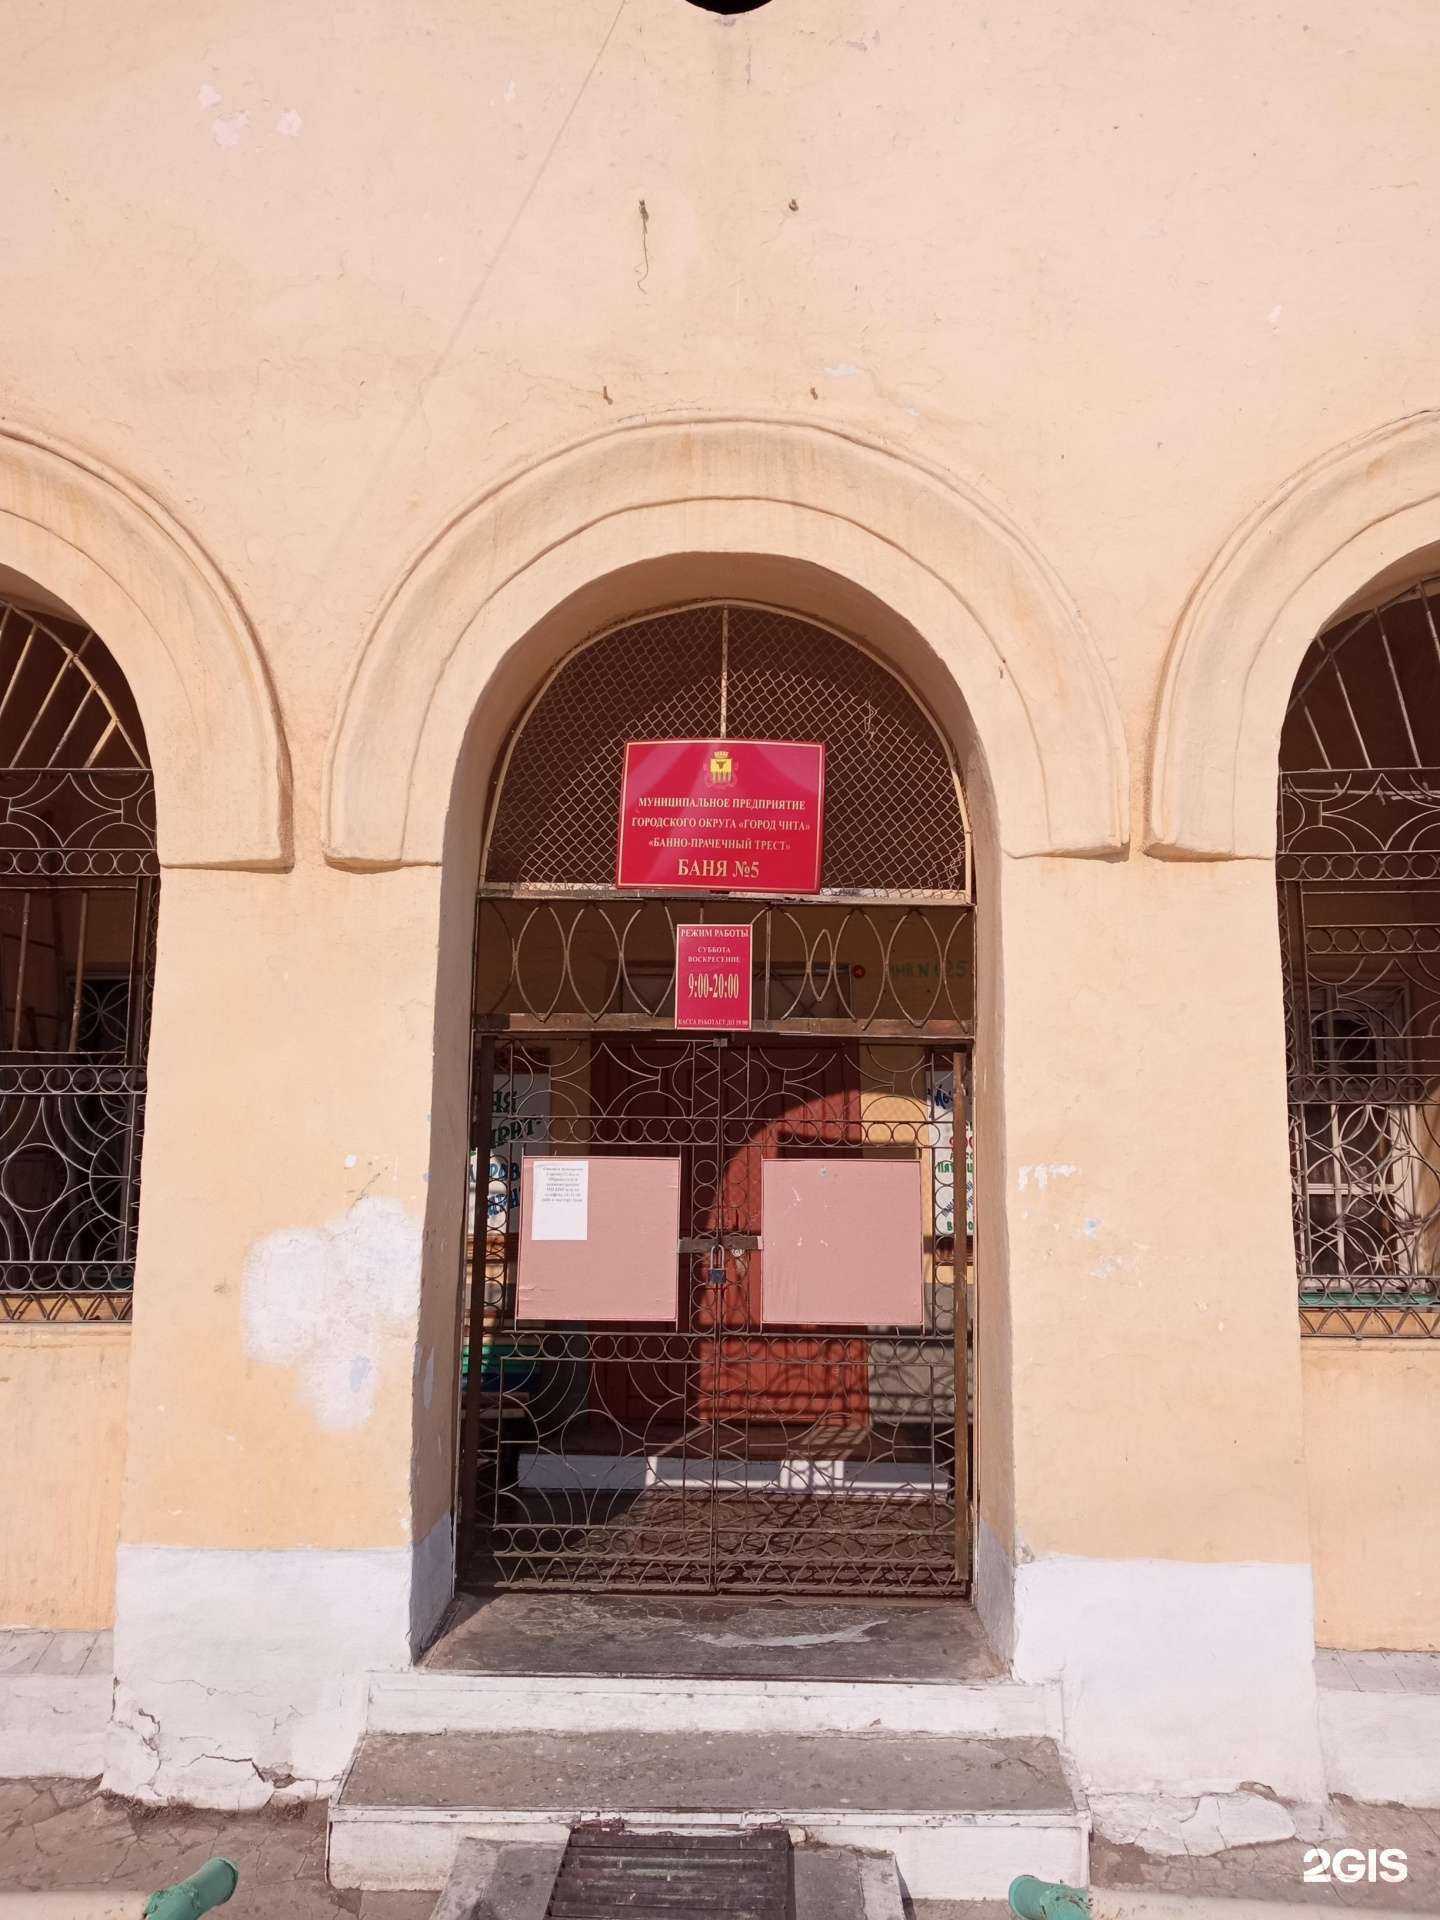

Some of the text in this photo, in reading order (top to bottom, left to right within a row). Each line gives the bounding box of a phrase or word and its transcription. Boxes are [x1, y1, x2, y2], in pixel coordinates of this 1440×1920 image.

[638, 797, 807, 810] МУНИЦИПАЛЬНОЕ ПРЕДПРИЯТИЕ
[631, 817, 811, 831] ГОРОДСКОГО ОКРУГА «ГОРОД ЧИТА»
[648, 836, 791, 851] «БАННО-ПРАЧЕЧНЫЙ ТРЕСТ»
[677, 858, 760, 878] БАНЯ №5
[681, 928, 749, 937] РЕЖИМ РАБОТЫ
[697, 946, 731, 954] СУББОТА
[688, 973, 740, 999] 9:00-20:00
